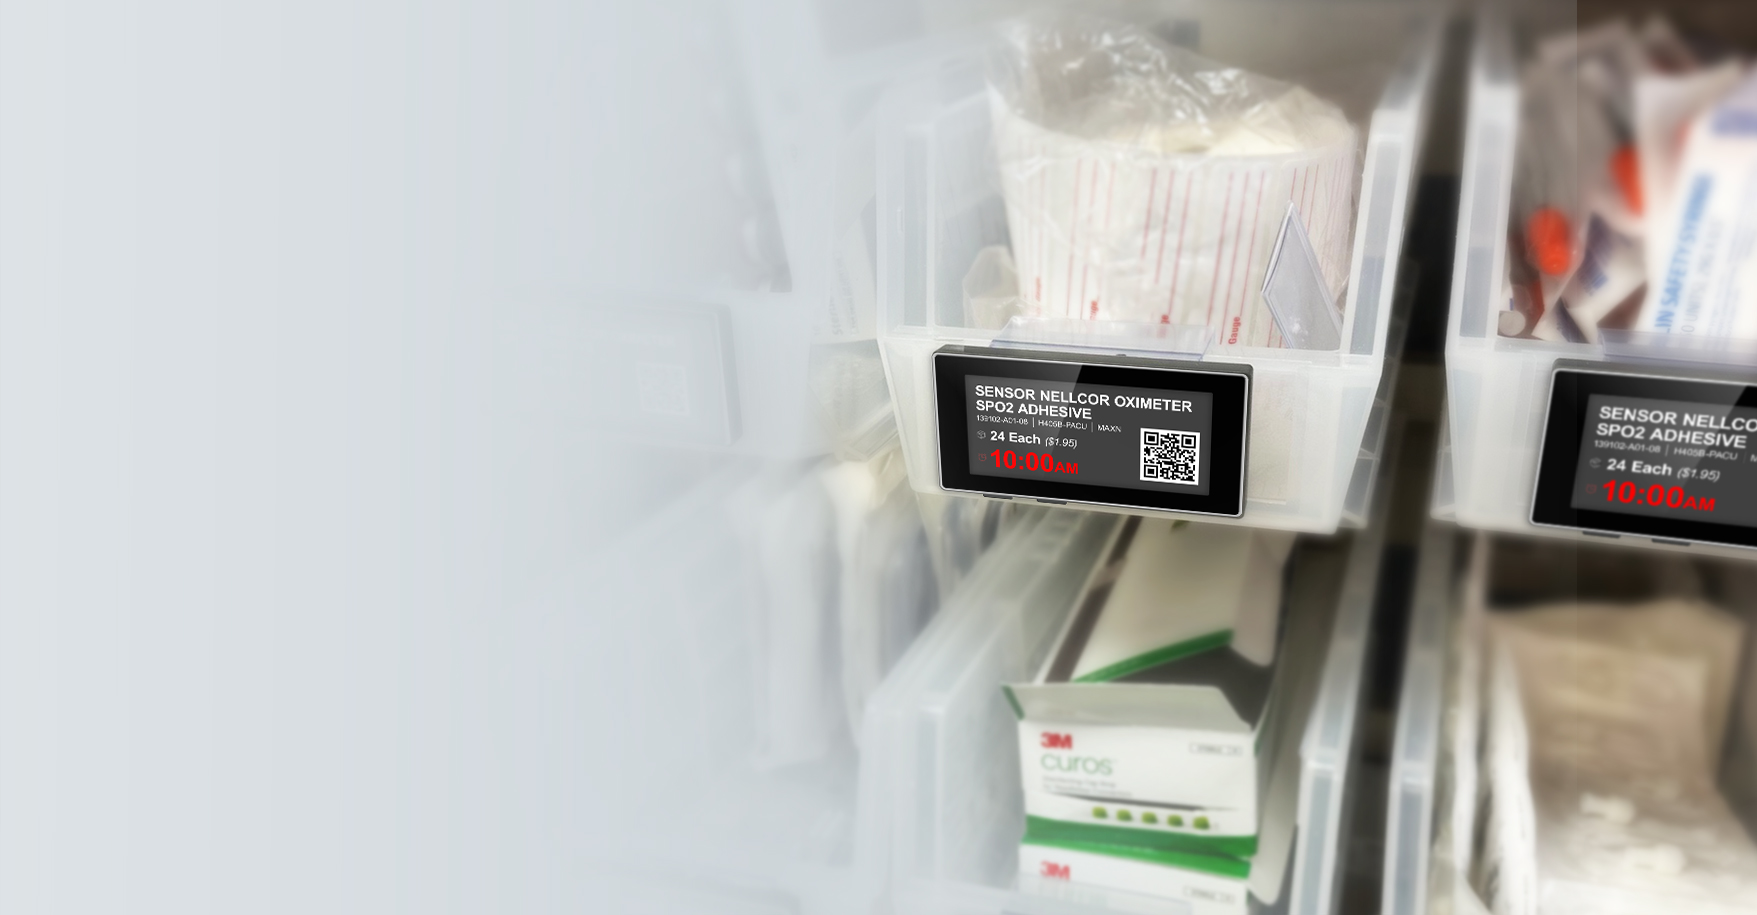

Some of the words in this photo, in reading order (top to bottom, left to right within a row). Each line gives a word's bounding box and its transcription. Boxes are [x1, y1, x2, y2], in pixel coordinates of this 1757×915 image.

[1228, 316, 1241, 345] Gauge
[975, 385, 1035, 400] SENSOR
[1040, 389, 1110, 406] NELLCOR
[1114, 395, 1192, 412] OXIMETER
[976, 400, 1014, 414] SPO2
[1018, 403, 1092, 420] ADHESIVE
[1097, 424, 1121, 433] MAXN
[1599, 405, 1677, 425] SENSOR
[1682, 412, 1757, 432] NELLCO
[990, 430, 1005, 441] 24
[1009, 431, 1040, 444] Each
[1045, 436, 1078, 449] ($1.95)
[1596, 422, 1646, 439] SPO2
[1649, 427, 1748, 449] ADHESIVE
[1606, 458, 1627, 471] 24
[1631, 460, 1672, 476] Each
[1677, 467, 1721, 483] ($1.95)
[1040, 732, 1073, 750] 3M
[1041, 753, 1113, 776] curos
[1040, 861, 1070, 880] 3M
